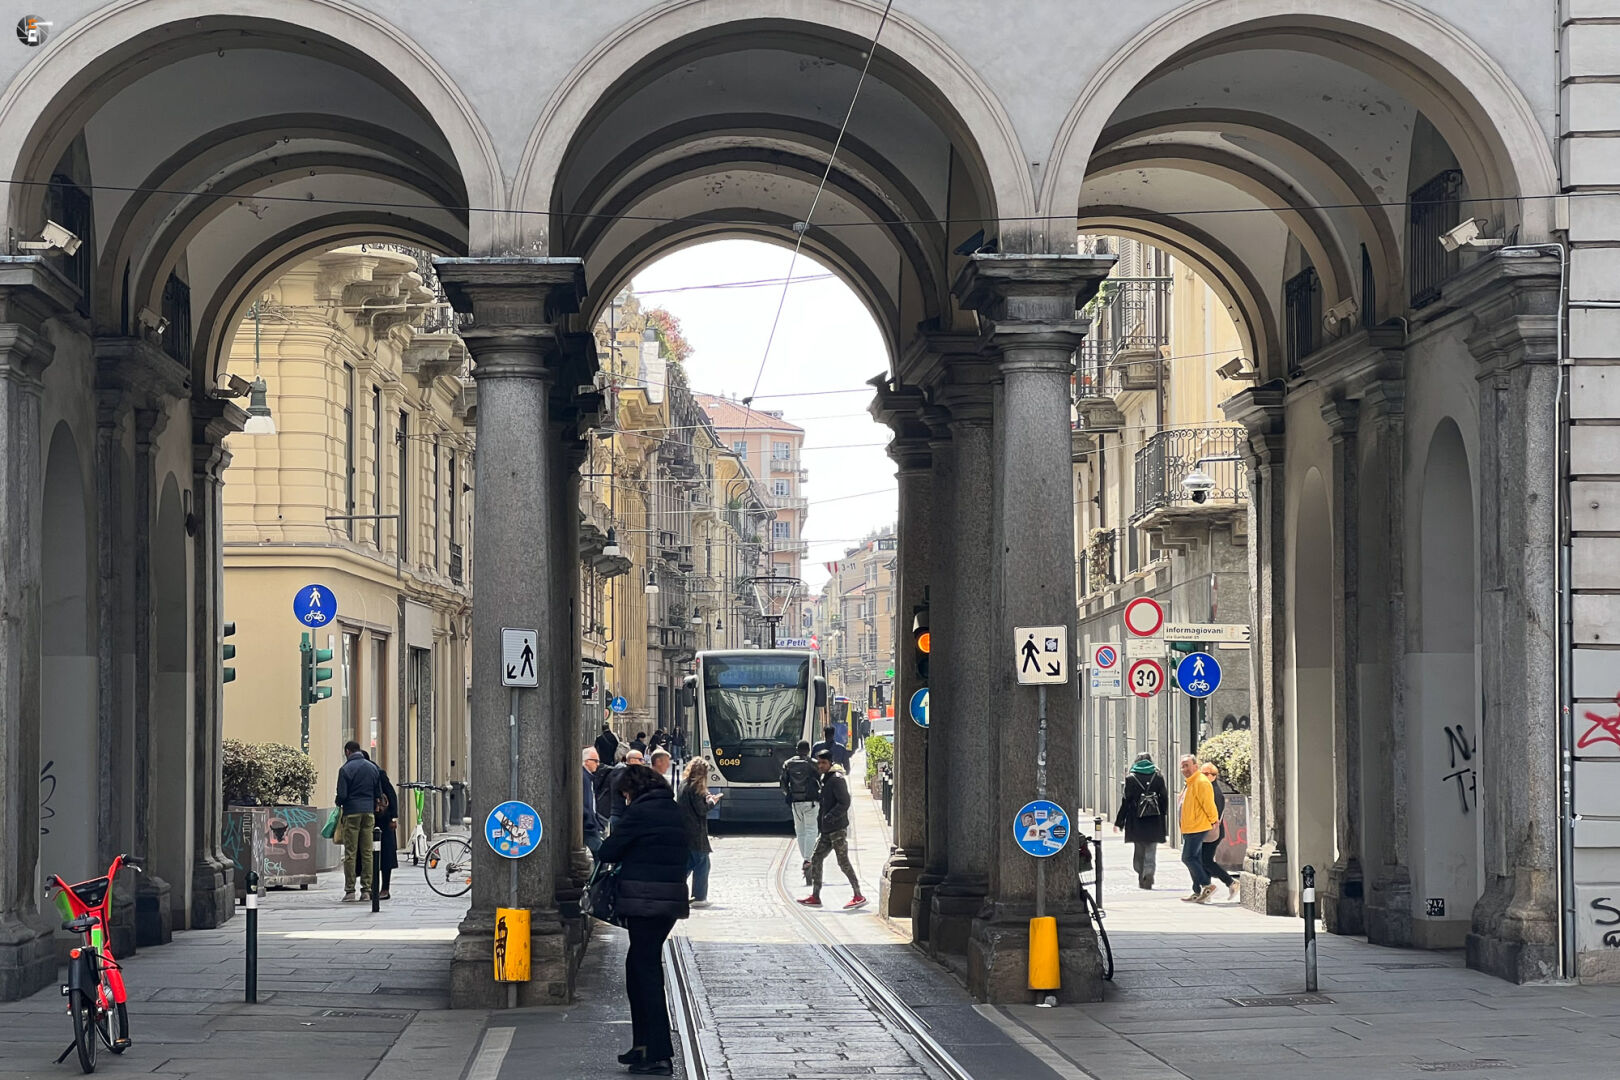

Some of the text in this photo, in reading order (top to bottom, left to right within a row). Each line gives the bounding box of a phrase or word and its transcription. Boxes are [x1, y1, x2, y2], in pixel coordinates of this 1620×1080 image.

[1166, 627, 1224, 635] informagiovani
[787, 639, 806, 647] Petit
[1136, 669, 1156, 687] 30
[719, 758, 740, 766] 6049
